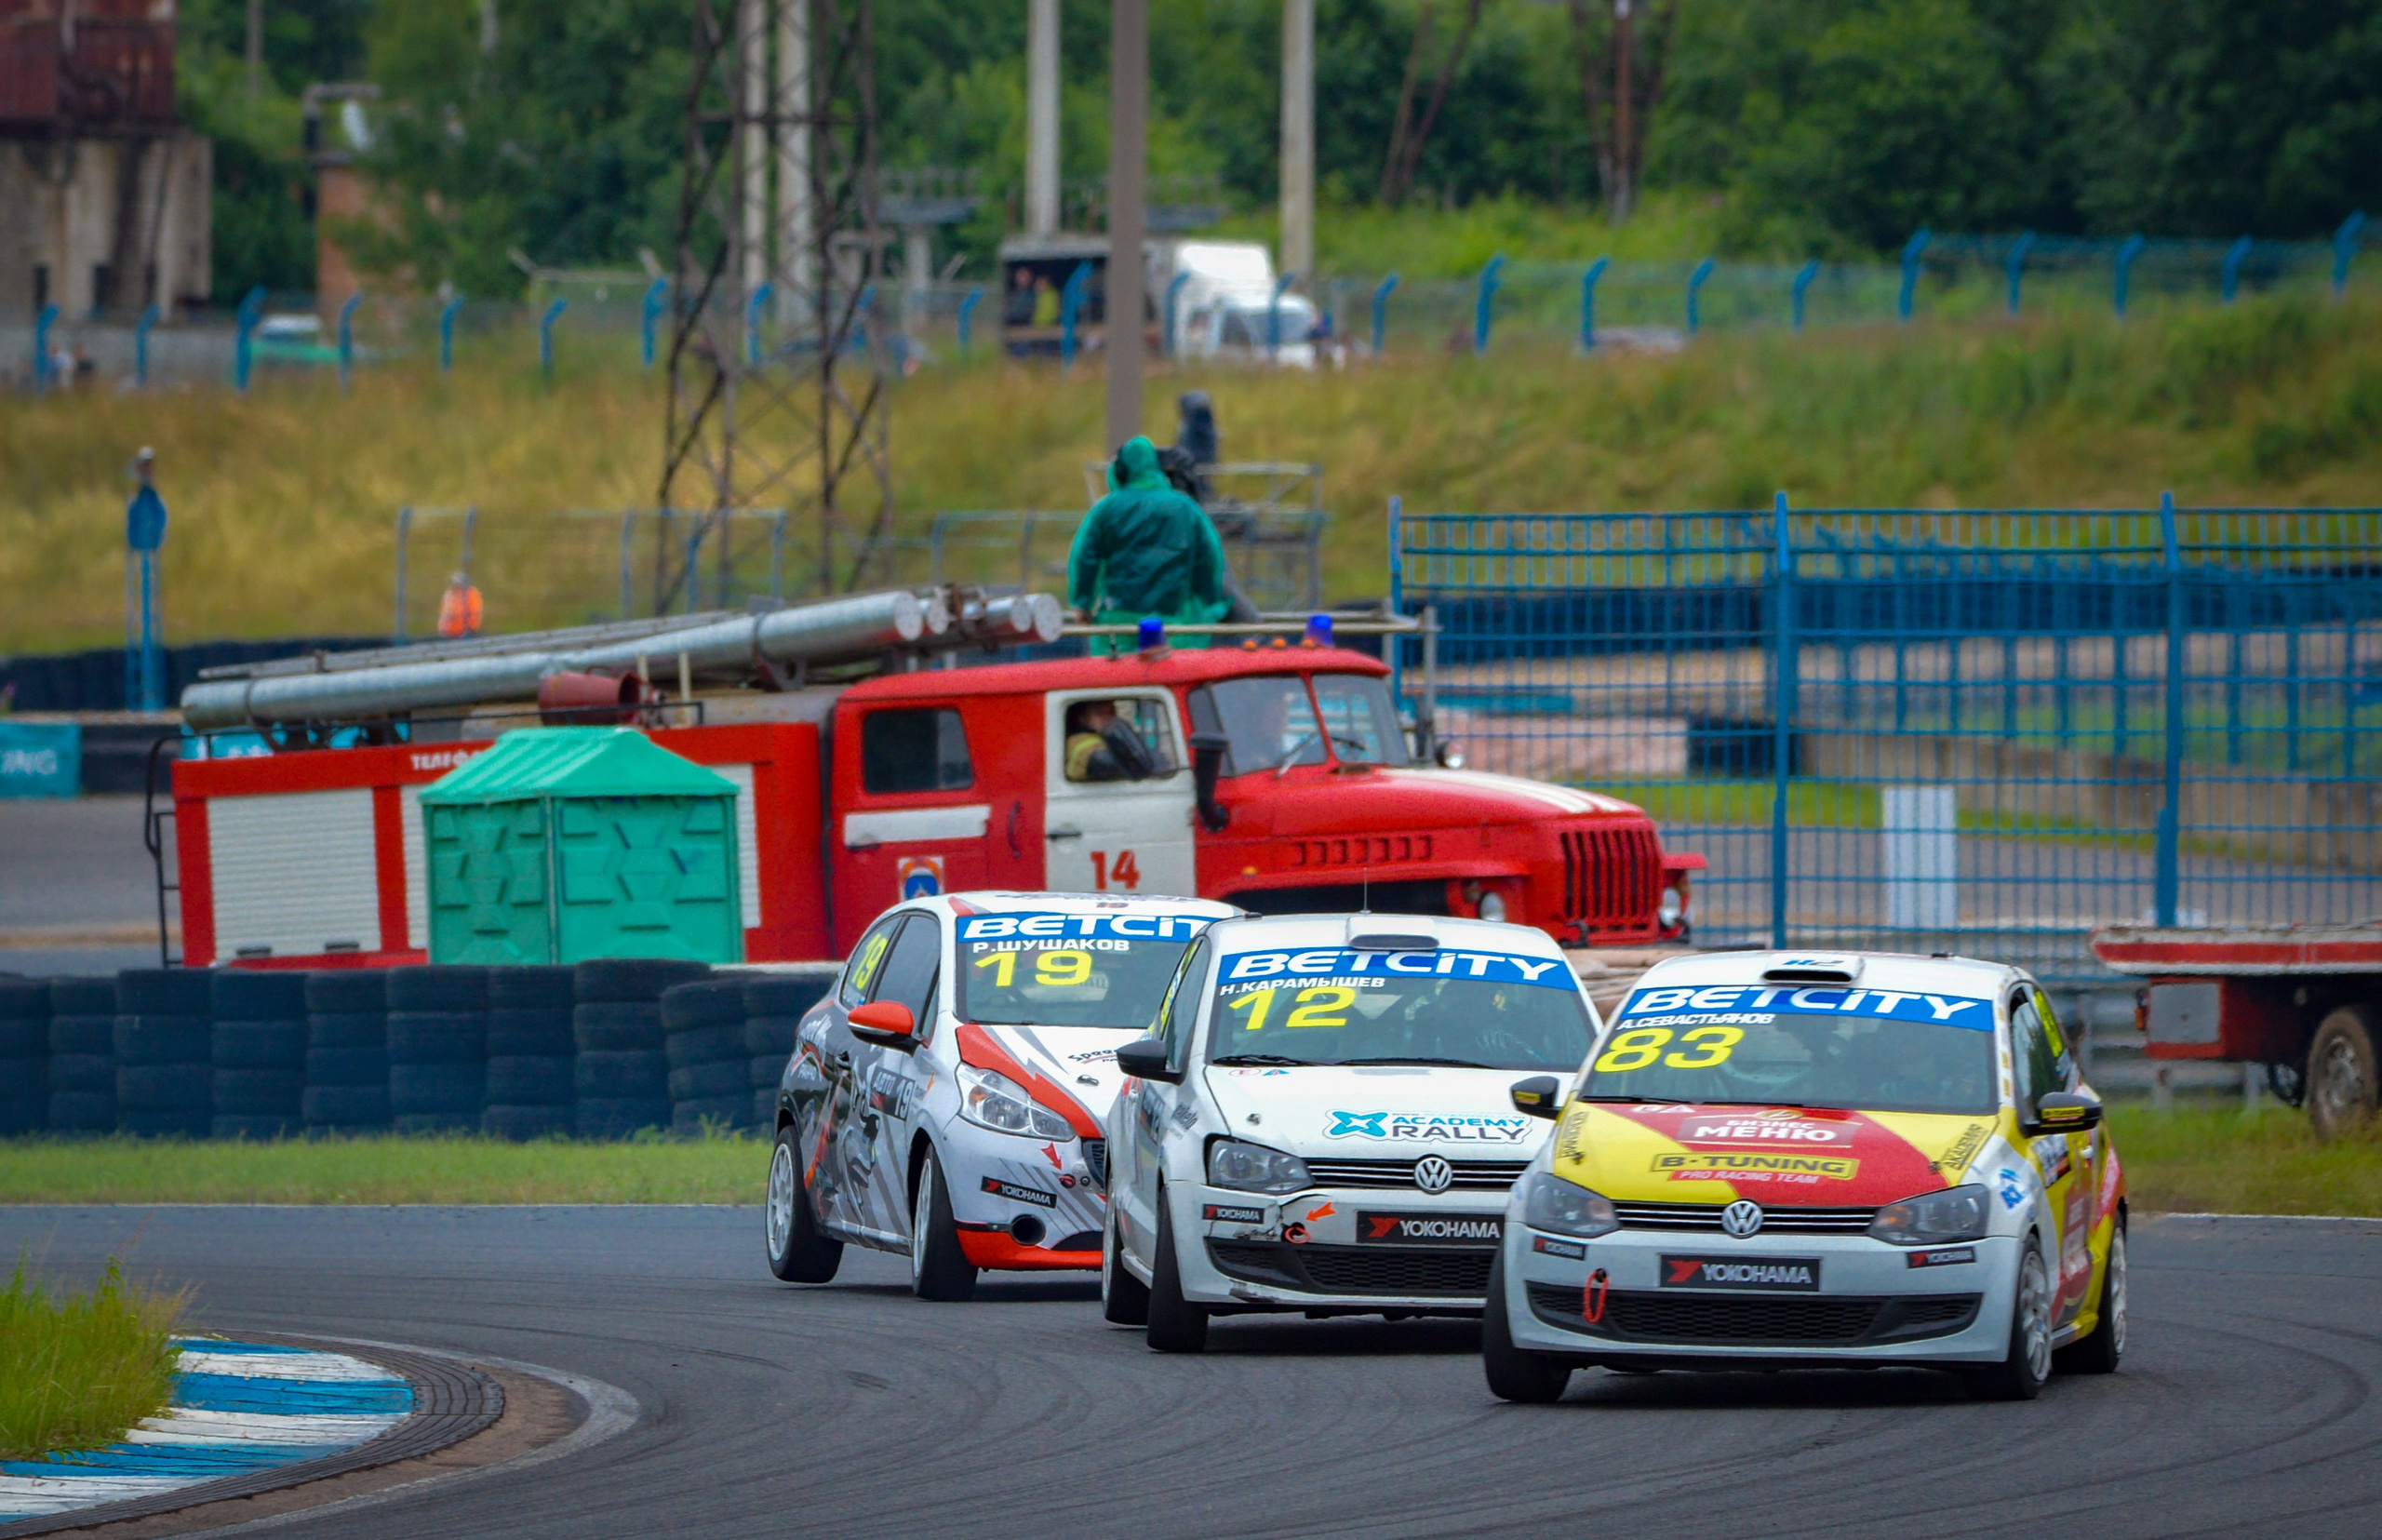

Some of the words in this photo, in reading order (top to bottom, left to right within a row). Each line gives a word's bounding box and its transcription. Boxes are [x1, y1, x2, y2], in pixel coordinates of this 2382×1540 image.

[1090, 850, 1141, 891] 14
[963, 914, 1210, 939] BETCIT
[972, 938, 1131, 954] Р.ШУШАКОВ
[851, 933, 889, 990] 19
[974, 949, 1093, 988] 19
[1228, 949, 1559, 982] BETCITY
[1219, 976, 1386, 997] Н.КАРАМЫШЕВ
[1228, 985, 1358, 1032] 12
[1626, 984, 1980, 1021] BETCITY
[1067, 1049, 1117, 1062] Spee
[1594, 1025, 1746, 1074] 83
[894, 1078, 915, 1118] 19
[1391, 1116, 1526, 1127] ACADEMY
[1727, 1118, 1815, 1130] БИЗНЕС
[1393, 1125, 1526, 1141] RALLY
[1693, 1125, 1837, 1142] МЕНЮ
[1679, 1170, 1712, 1180] PRO
[1713, 1171, 1773, 1183] RACING
[1775, 1172, 1820, 1184] TEAM
[1000, 1184, 1051, 1205] YOKOHAMA
[1216, 1208, 1261, 1221] YOKOHAMA
[1398, 1220, 1501, 1239] YOKOHAMA
[1701, 1262, 1813, 1284] YOKOHAMA
